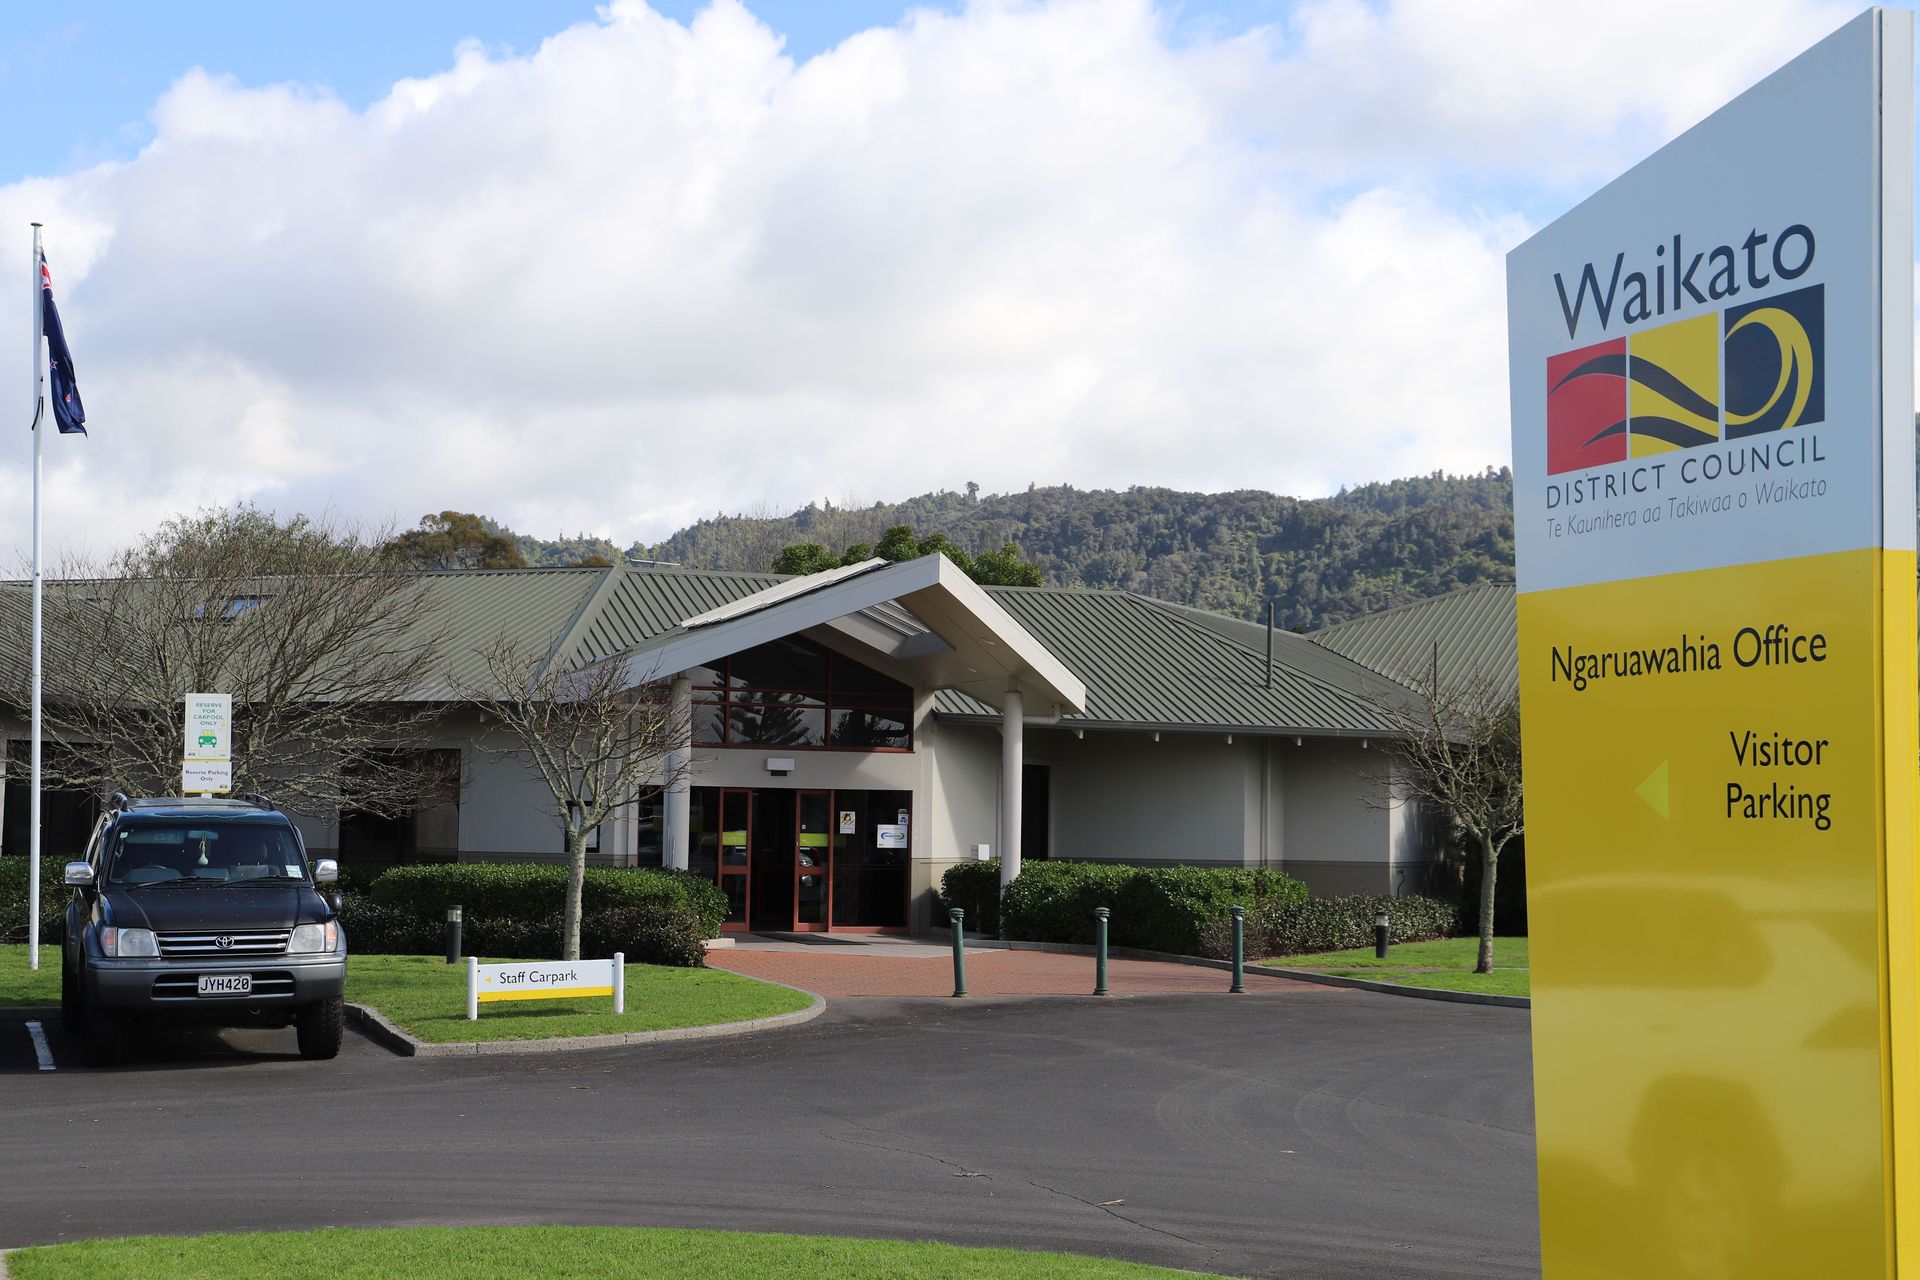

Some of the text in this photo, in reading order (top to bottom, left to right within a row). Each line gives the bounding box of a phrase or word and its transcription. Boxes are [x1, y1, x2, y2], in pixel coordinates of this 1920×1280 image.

[1553, 223, 1816, 340] Waikato
[1547, 435, 1826, 509] DISTRICT COUNCIL
[1547, 476, 1827, 539] Te Kaunihera aa Takiwaa o Waikato
[1551, 623, 1828, 692] Ngaruawahia Office
[1729, 730, 1829, 767] Visitor
[1726, 782, 1832, 831] Parking
[200, 978, 249, 991] JYH420
[499, 969, 578, 986] Staff Carpark
